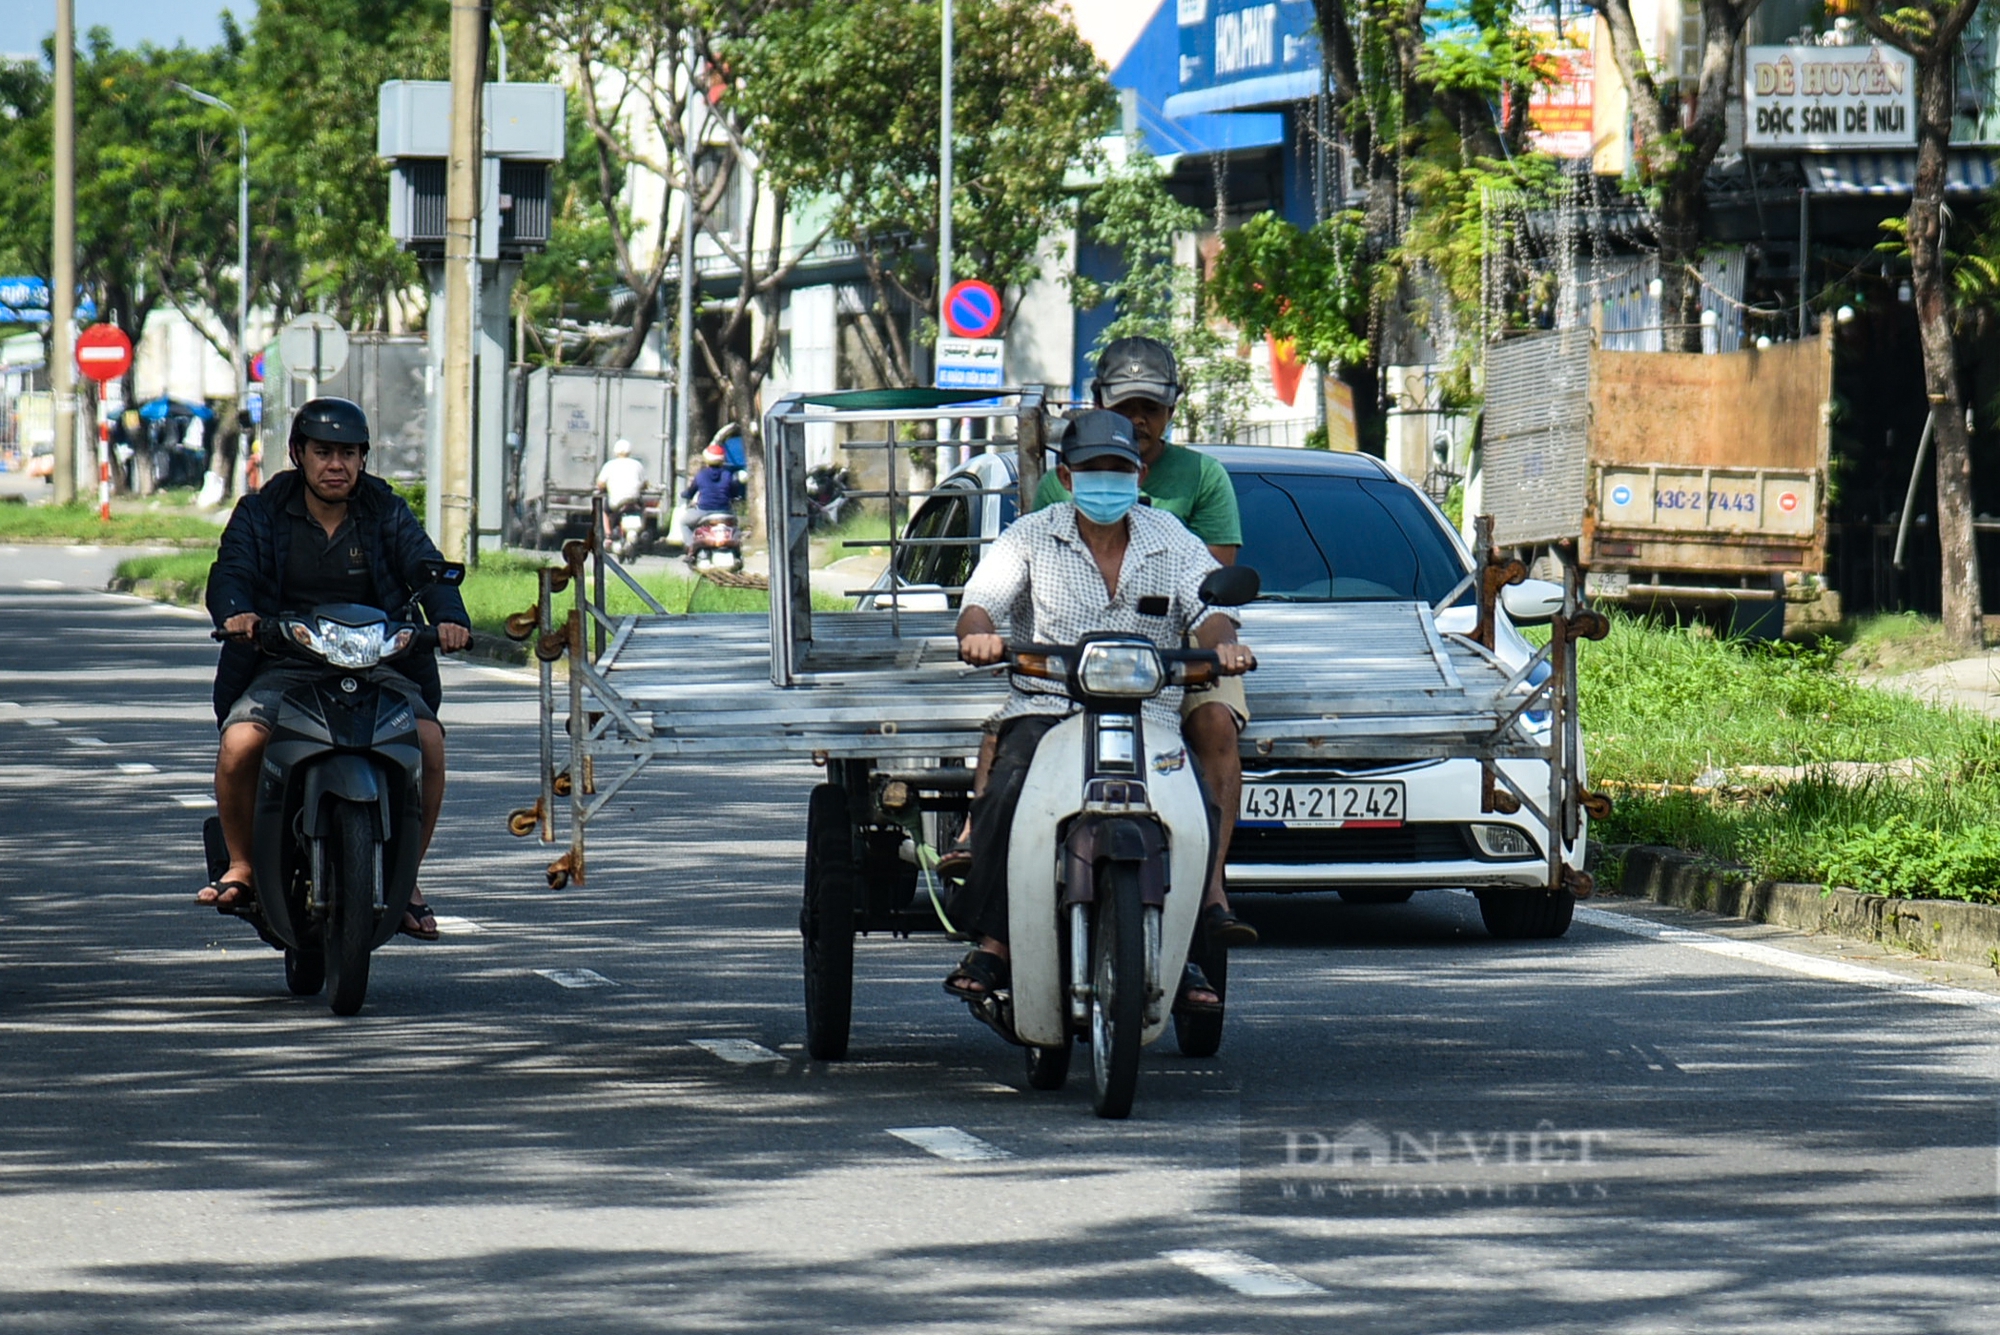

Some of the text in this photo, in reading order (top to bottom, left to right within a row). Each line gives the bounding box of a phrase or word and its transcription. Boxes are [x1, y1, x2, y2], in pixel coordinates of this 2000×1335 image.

[1755, 54, 1795, 96] DÊ
[1756, 99, 1905, 141] ĐẶC SẢN DÊ NÚI
[1246, 787, 1399, 818] 43A-212.42
